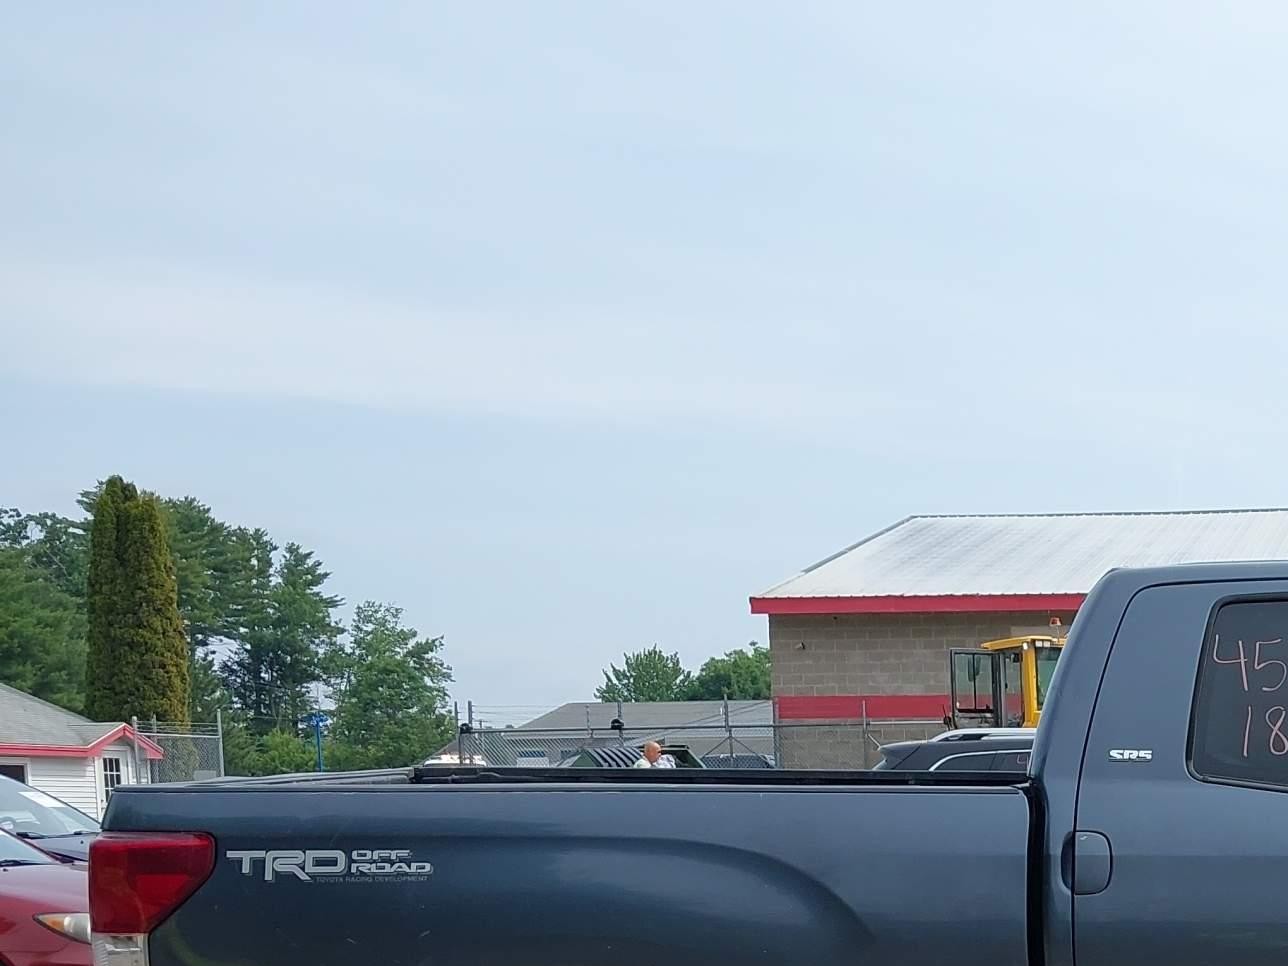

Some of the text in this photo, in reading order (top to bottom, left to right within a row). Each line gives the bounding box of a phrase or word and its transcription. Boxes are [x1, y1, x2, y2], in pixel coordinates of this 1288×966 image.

[351, 849, 412, 861] OFF
[226, 850, 348, 882] TRD
[350, 862, 434, 875] ROAD
